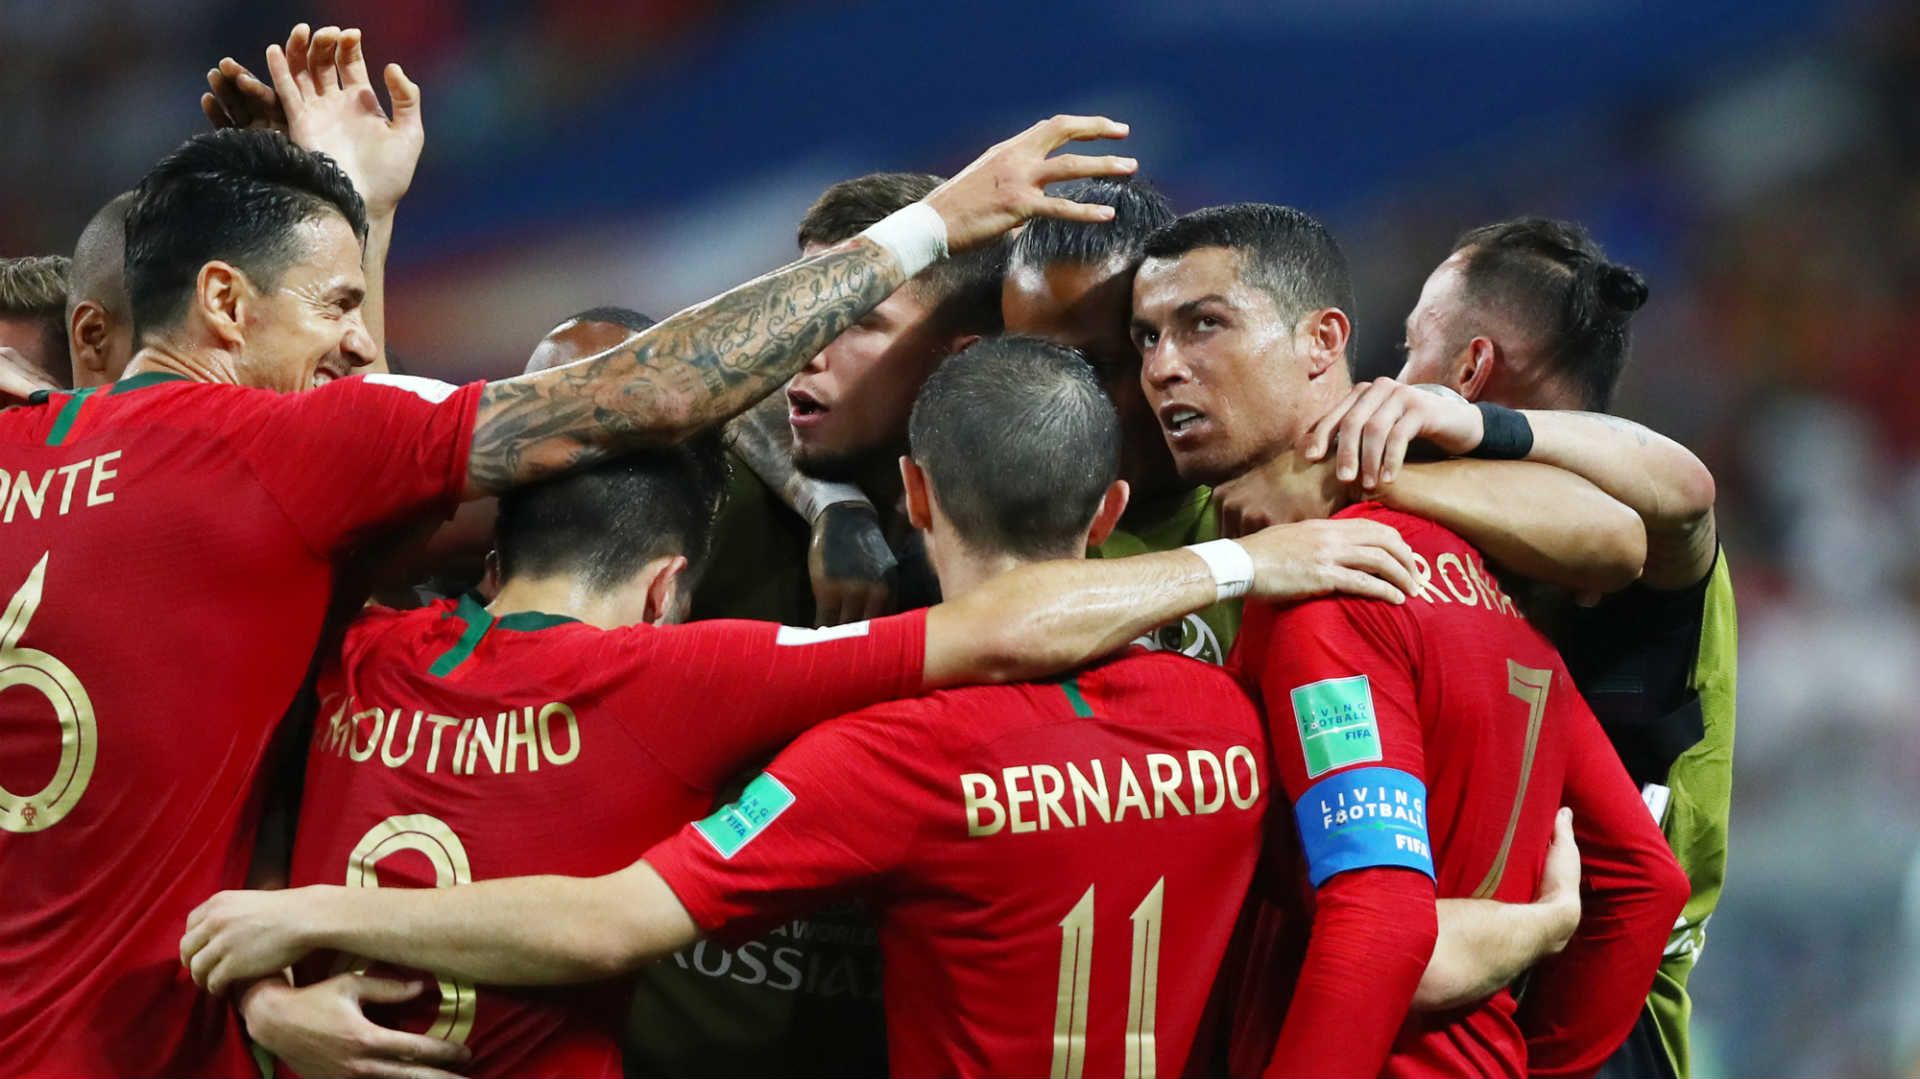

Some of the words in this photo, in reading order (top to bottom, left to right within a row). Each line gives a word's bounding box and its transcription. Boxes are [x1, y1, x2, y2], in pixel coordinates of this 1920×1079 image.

[0, 549, 98, 833] 6
[1302, 702, 1367, 724] LIVING
[319, 696, 581, 775] MOUTINHO
[1345, 729, 1372, 741] FIFA
[960, 745, 1260, 837] BERNARDO
[1320, 786, 1423, 814] LIVING
[1473, 658, 1553, 899] 7
[1323, 803, 1425, 831] FOOTBALL
[1395, 833, 1431, 859] FIFA
[1049, 877, 1164, 1079] 11
